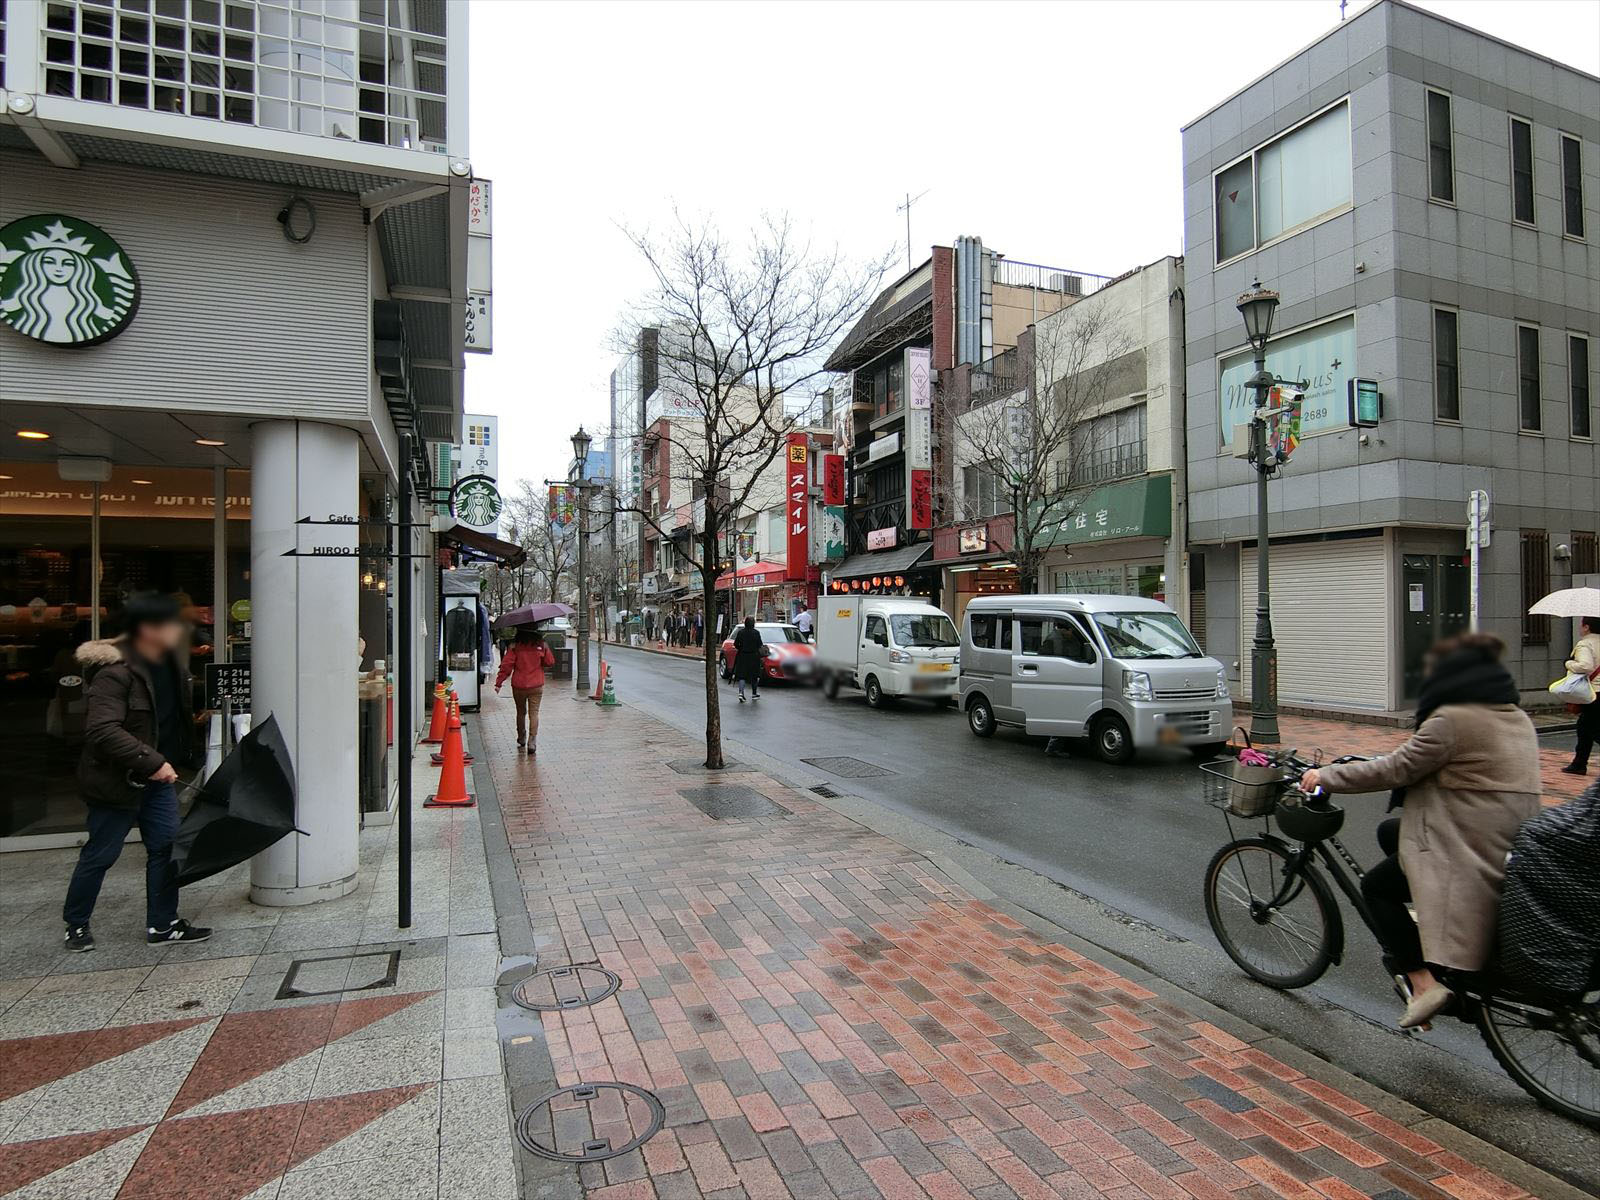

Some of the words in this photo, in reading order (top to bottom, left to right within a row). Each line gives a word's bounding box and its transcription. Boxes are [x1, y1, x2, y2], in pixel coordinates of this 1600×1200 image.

[791, 447, 805, 462] 薬
[790, 474, 807, 536] スマイル
[328, 513, 354, 523] Cafe
[313, 546, 350, 555] HIROO
